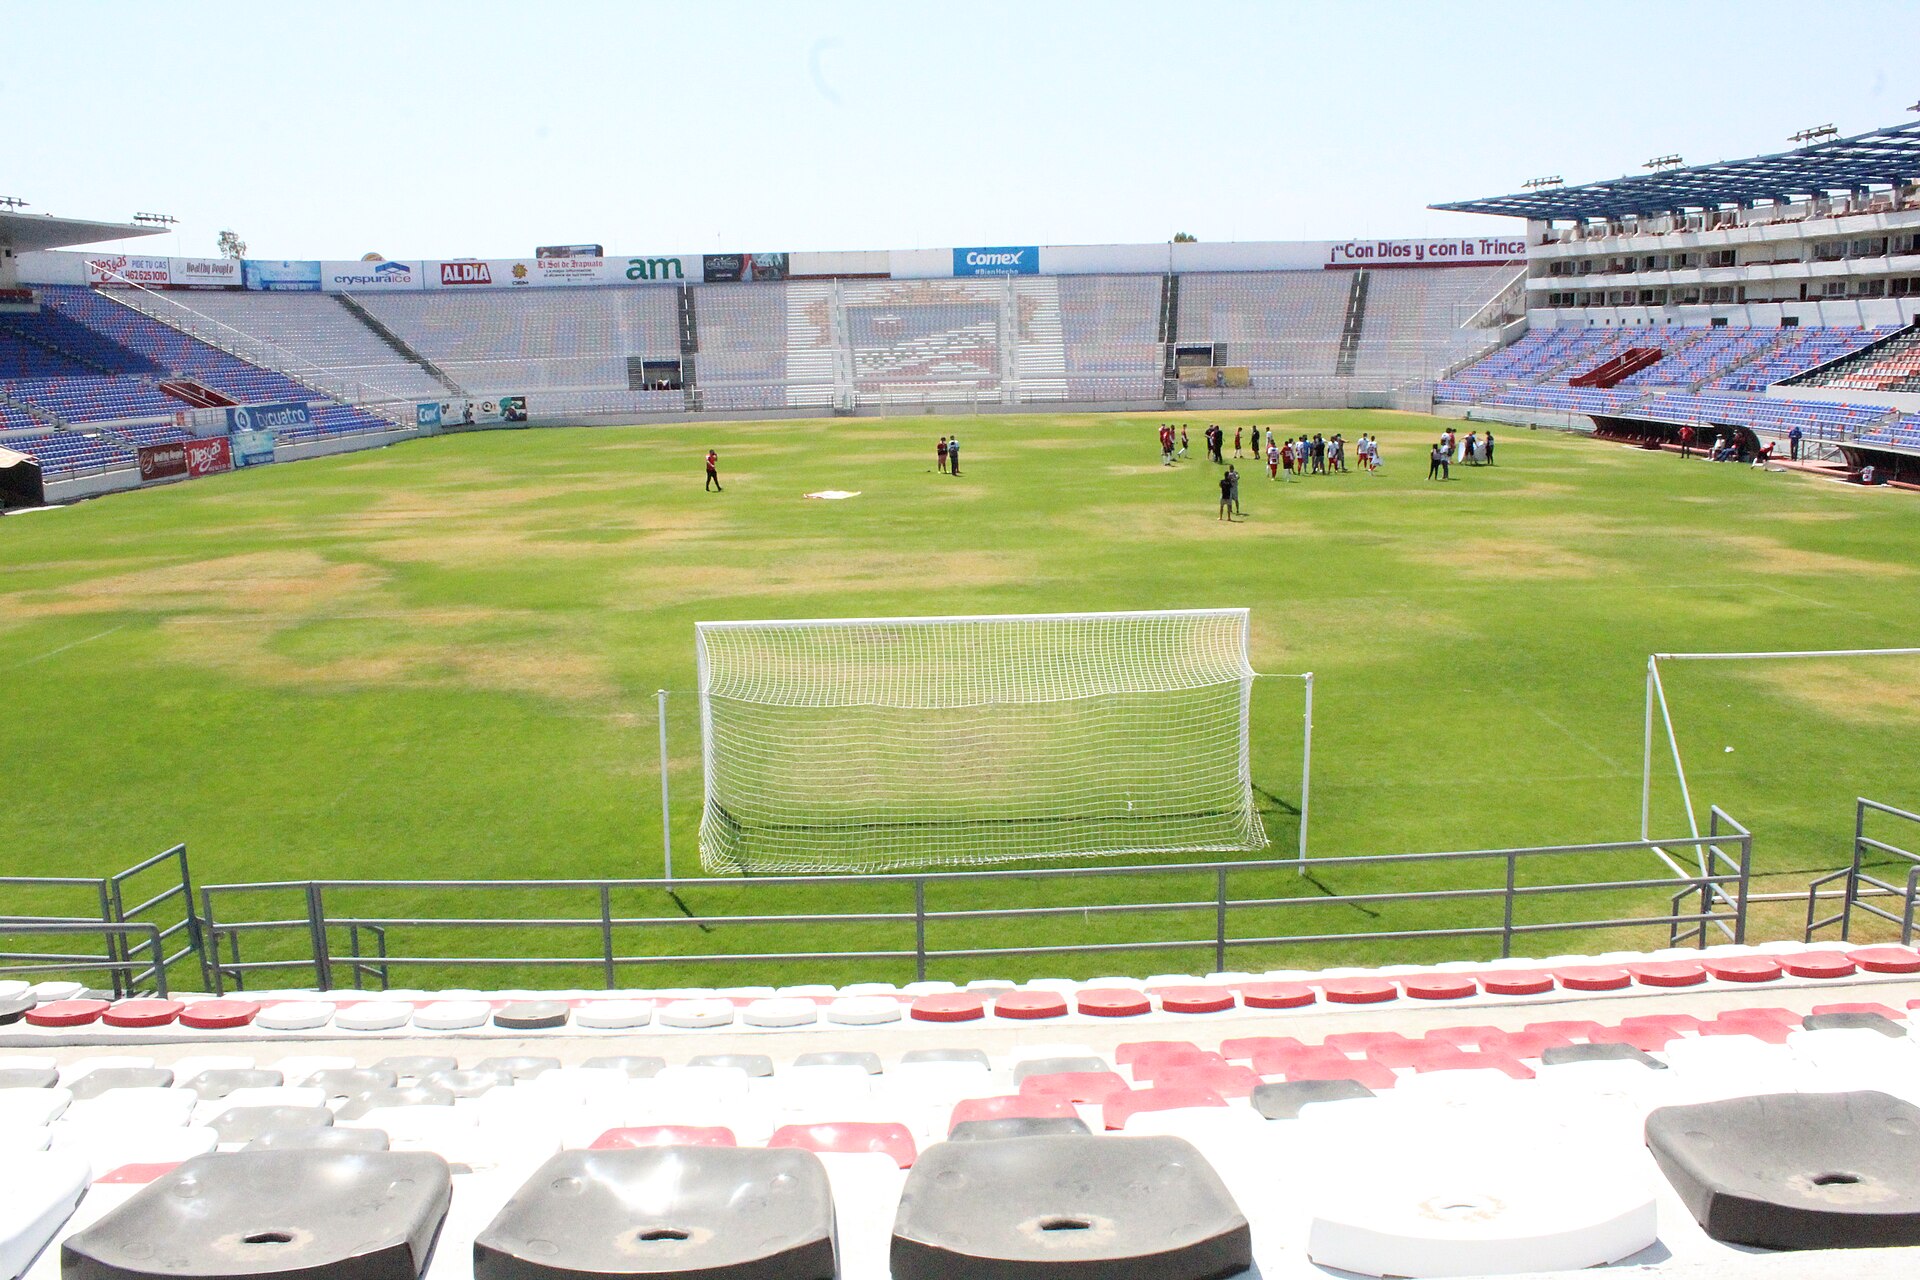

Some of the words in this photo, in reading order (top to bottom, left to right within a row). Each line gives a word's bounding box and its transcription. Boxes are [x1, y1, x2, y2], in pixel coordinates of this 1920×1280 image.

[1378, 242, 1411, 258] Dios
[1415, 245, 1424, 260] y
[1429, 243, 1457, 256] con
[1461, 240, 1474, 255] la
[1479, 239, 1526, 254] Trinca
[537, 261, 546, 269] El
[547, 260, 560, 269] Sol
[561, 260, 569, 268] de
[570, 259, 603, 269] Irapuato
[966, 250, 1024, 265] Comex
[131, 260, 144, 268] PIDE
[145, 260, 153, 268] TU
[154, 260, 167, 269] GAS
[186, 262, 210, 274] Healthy
[212, 262, 234, 274] People
[625, 257, 684, 280] am
